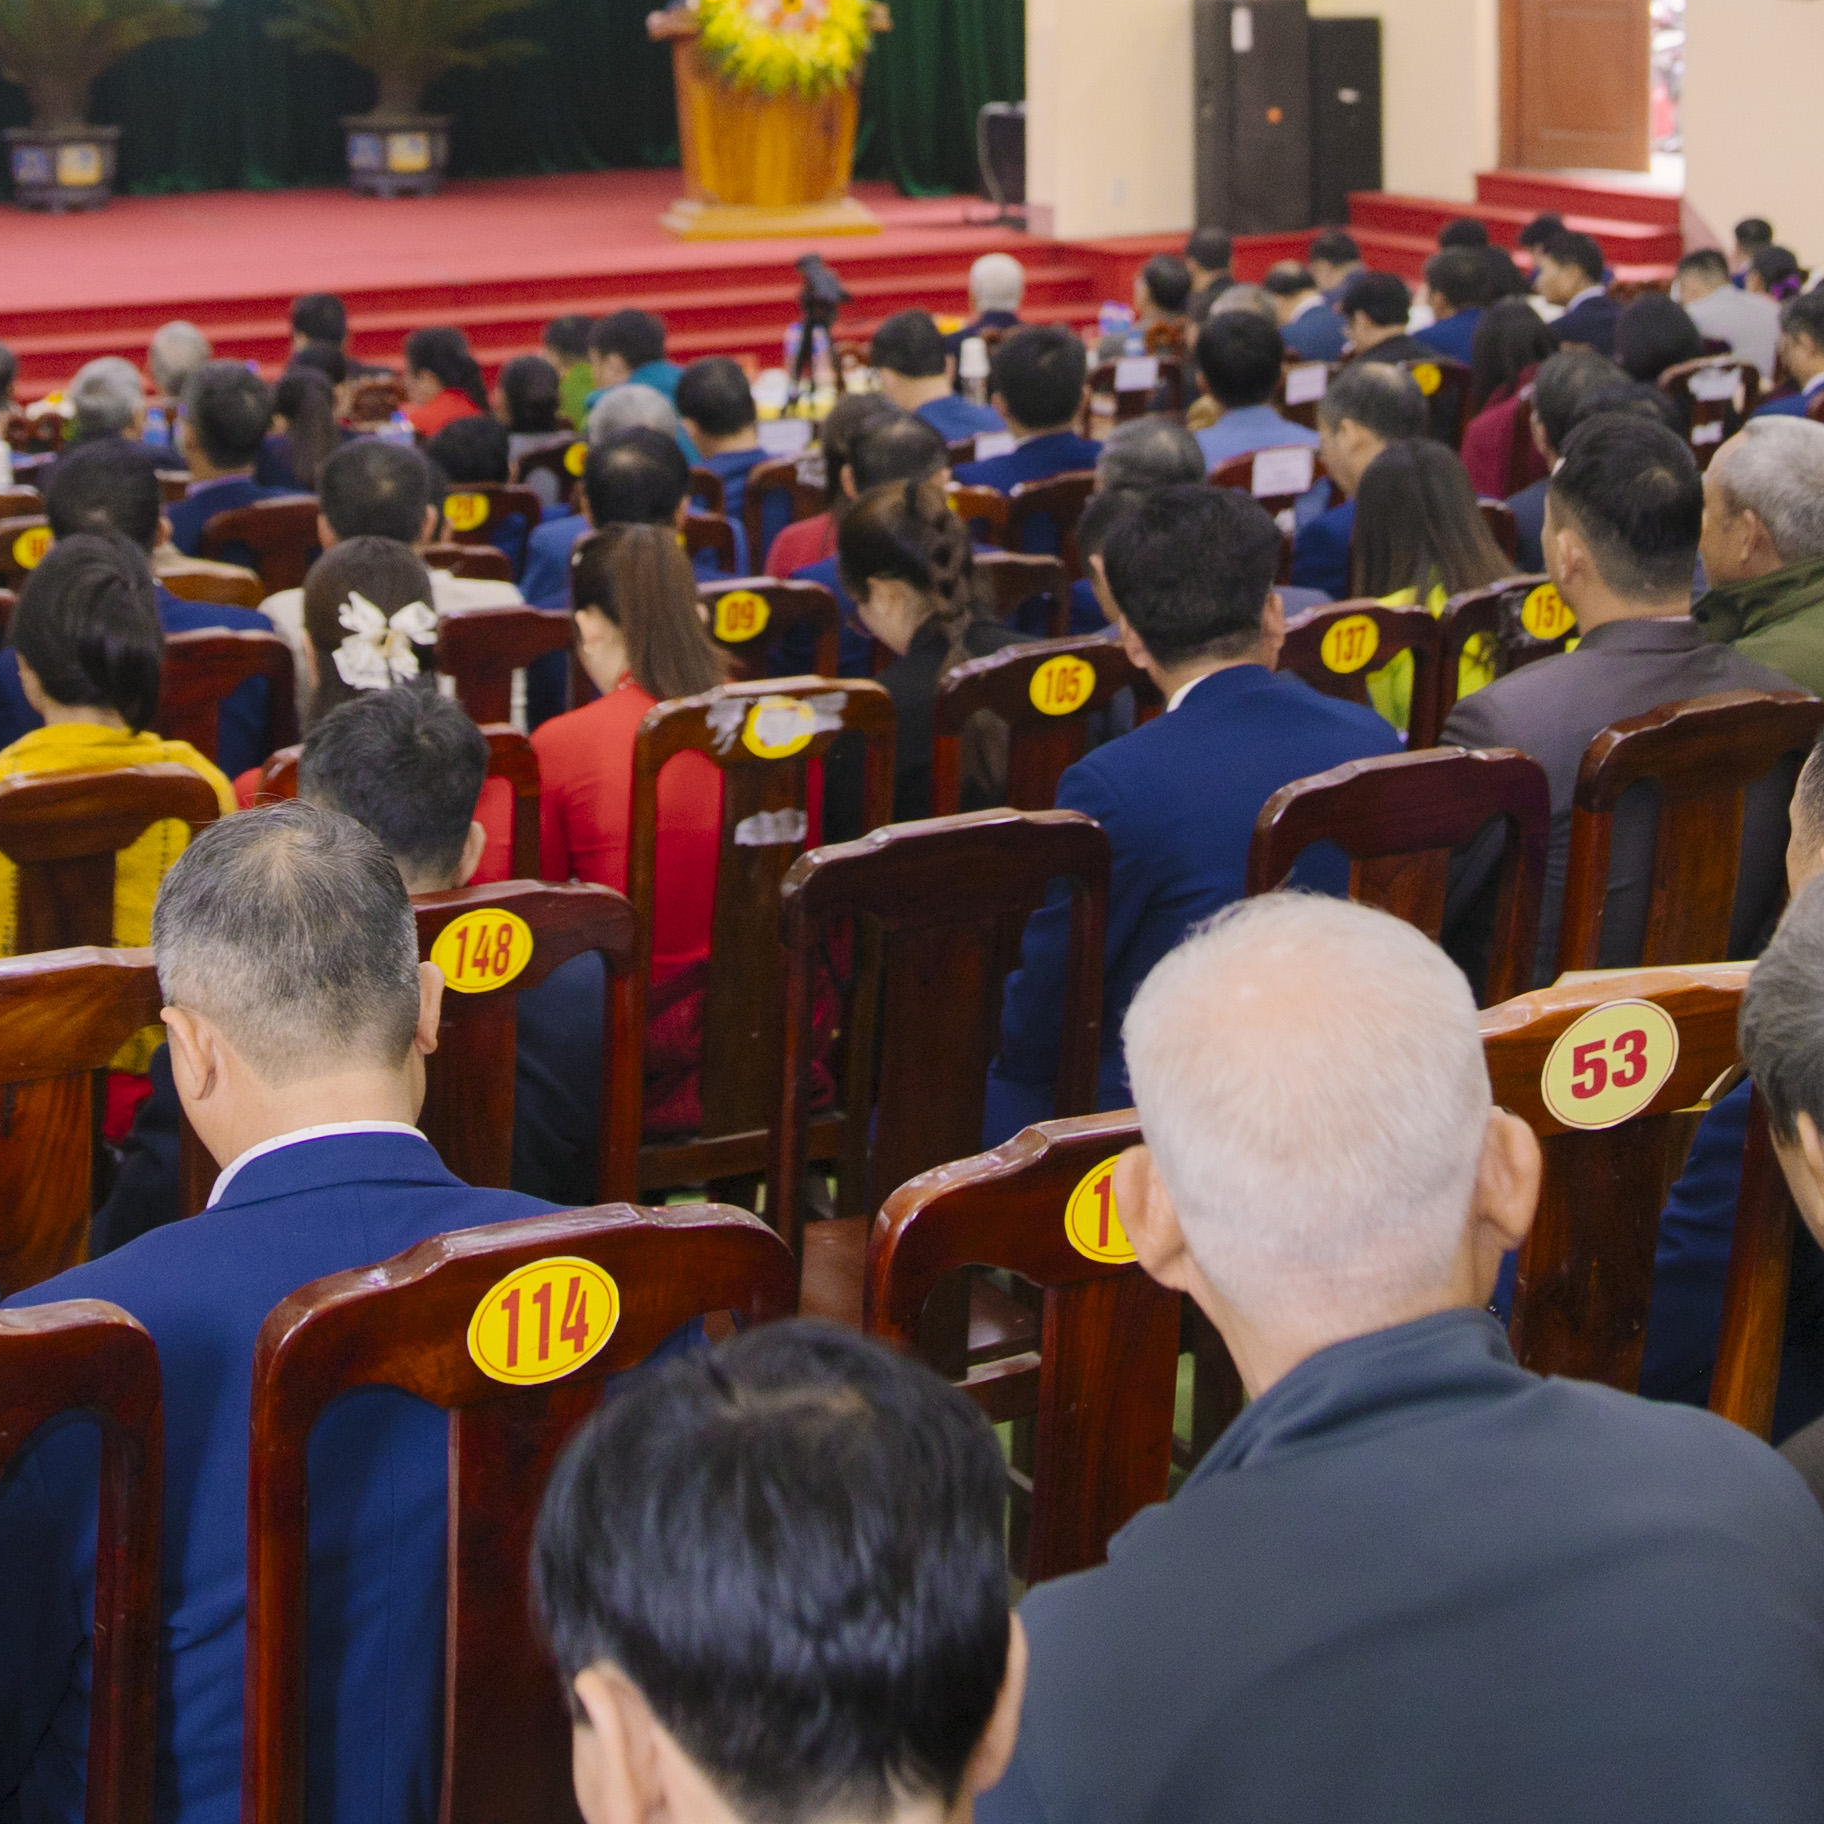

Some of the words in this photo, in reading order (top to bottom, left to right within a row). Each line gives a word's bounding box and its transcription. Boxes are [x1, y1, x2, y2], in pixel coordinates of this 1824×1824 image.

[1334, 626, 1368, 663] 137
[1042, 667, 1084, 705] 105
[454, 923, 514, 980] 148
[1571, 1029, 1648, 1100] 53
[499, 1274, 590, 1370] 114
